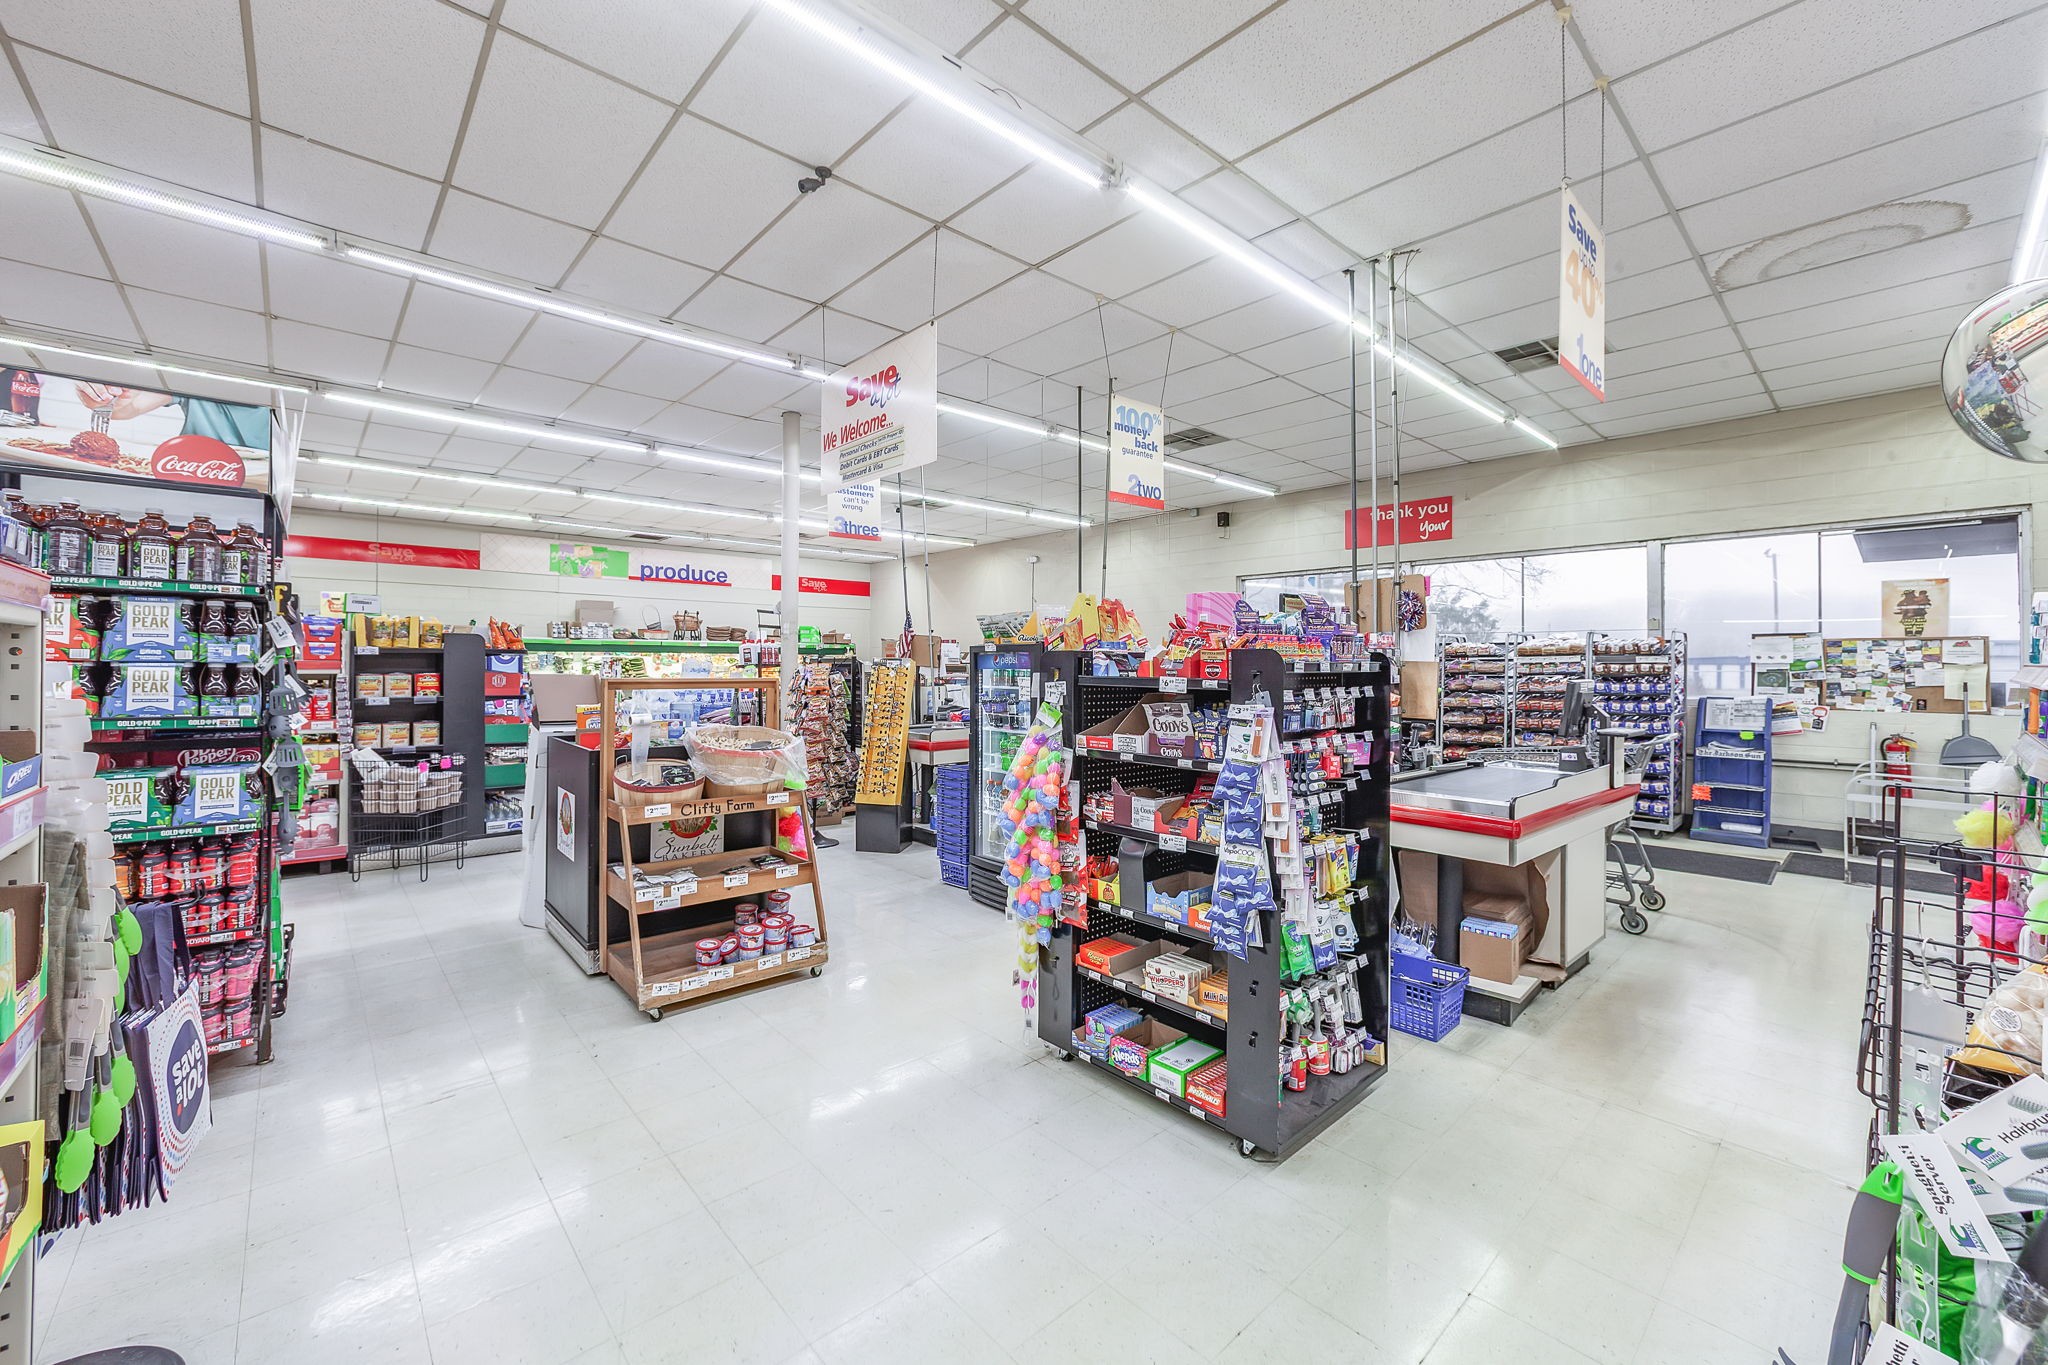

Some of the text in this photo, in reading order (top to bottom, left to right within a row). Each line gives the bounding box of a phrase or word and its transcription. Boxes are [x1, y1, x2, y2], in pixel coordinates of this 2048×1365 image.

[1568, 204, 1597, 262] Save
[1579, 246, 1596, 277] up to
[1582, 358, 1602, 390] one
[846, 364, 898, 407] Save
[823, 413, 894, 452] We Welcome...
[839, 446, 860, 459] Personal
[860, 440, 878, 452] Checks
[1134, 437, 1158, 453] back
[840, 460, 853, 471] Debit
[853, 456, 868, 466] Cards
[873, 450, 883, 459] EBT
[883, 443, 899, 455] Cards
[1121, 446, 1154, 460] guarantee
[156, 454, 243, 483] Coca-Cola
[842, 463, 884, 480] Mastercard & Visa
[835, 488, 875, 499] ustomers
[1137, 480, 1162, 500] two
[843, 496, 860, 504] can't
[841, 503, 863, 513] wrong
[1370, 503, 1449, 521] hank you
[844, 520, 879, 537] three
[1420, 519, 1450, 540] your
[143, 547, 168, 557] GOLD
[367, 543, 414, 557] Save
[143, 556, 167, 565] PEAK
[640, 562, 729, 583] produce
[119, 579, 163, 588] GOLD PEAK
[801, 577, 828, 589] Save
[132, 605, 170, 617] GOLD
[132, 616, 169, 628] PEAK
[1000, 653, 1018, 666] pepsi
[132, 669, 170, 681] GOLD
[132, 681, 169, 693] PEAK
[143, 719, 161, 727] PEAK
[1152, 717, 1189, 732] CODY'S
[1698, 748, 1761, 759] The Jackson Sun
[6, 763, 33, 792] OREO
[200, 777, 235, 789] GOLD
[107, 782, 143, 794] GOLD
[200, 788, 234, 801] PEAK
[681, 799, 755, 816] Clifty Farm
[160, 829, 178, 837] GOLD
[654, 834, 722, 859] Sunbelt
[662, 848, 716, 861] BAKERY
[1150, 974, 1185, 987] WHOPPERS
[1203, 991, 1217, 1000] Milk
[172, 1038, 202, 1086] save
[1920, 1155, 1955, 1205] Server
